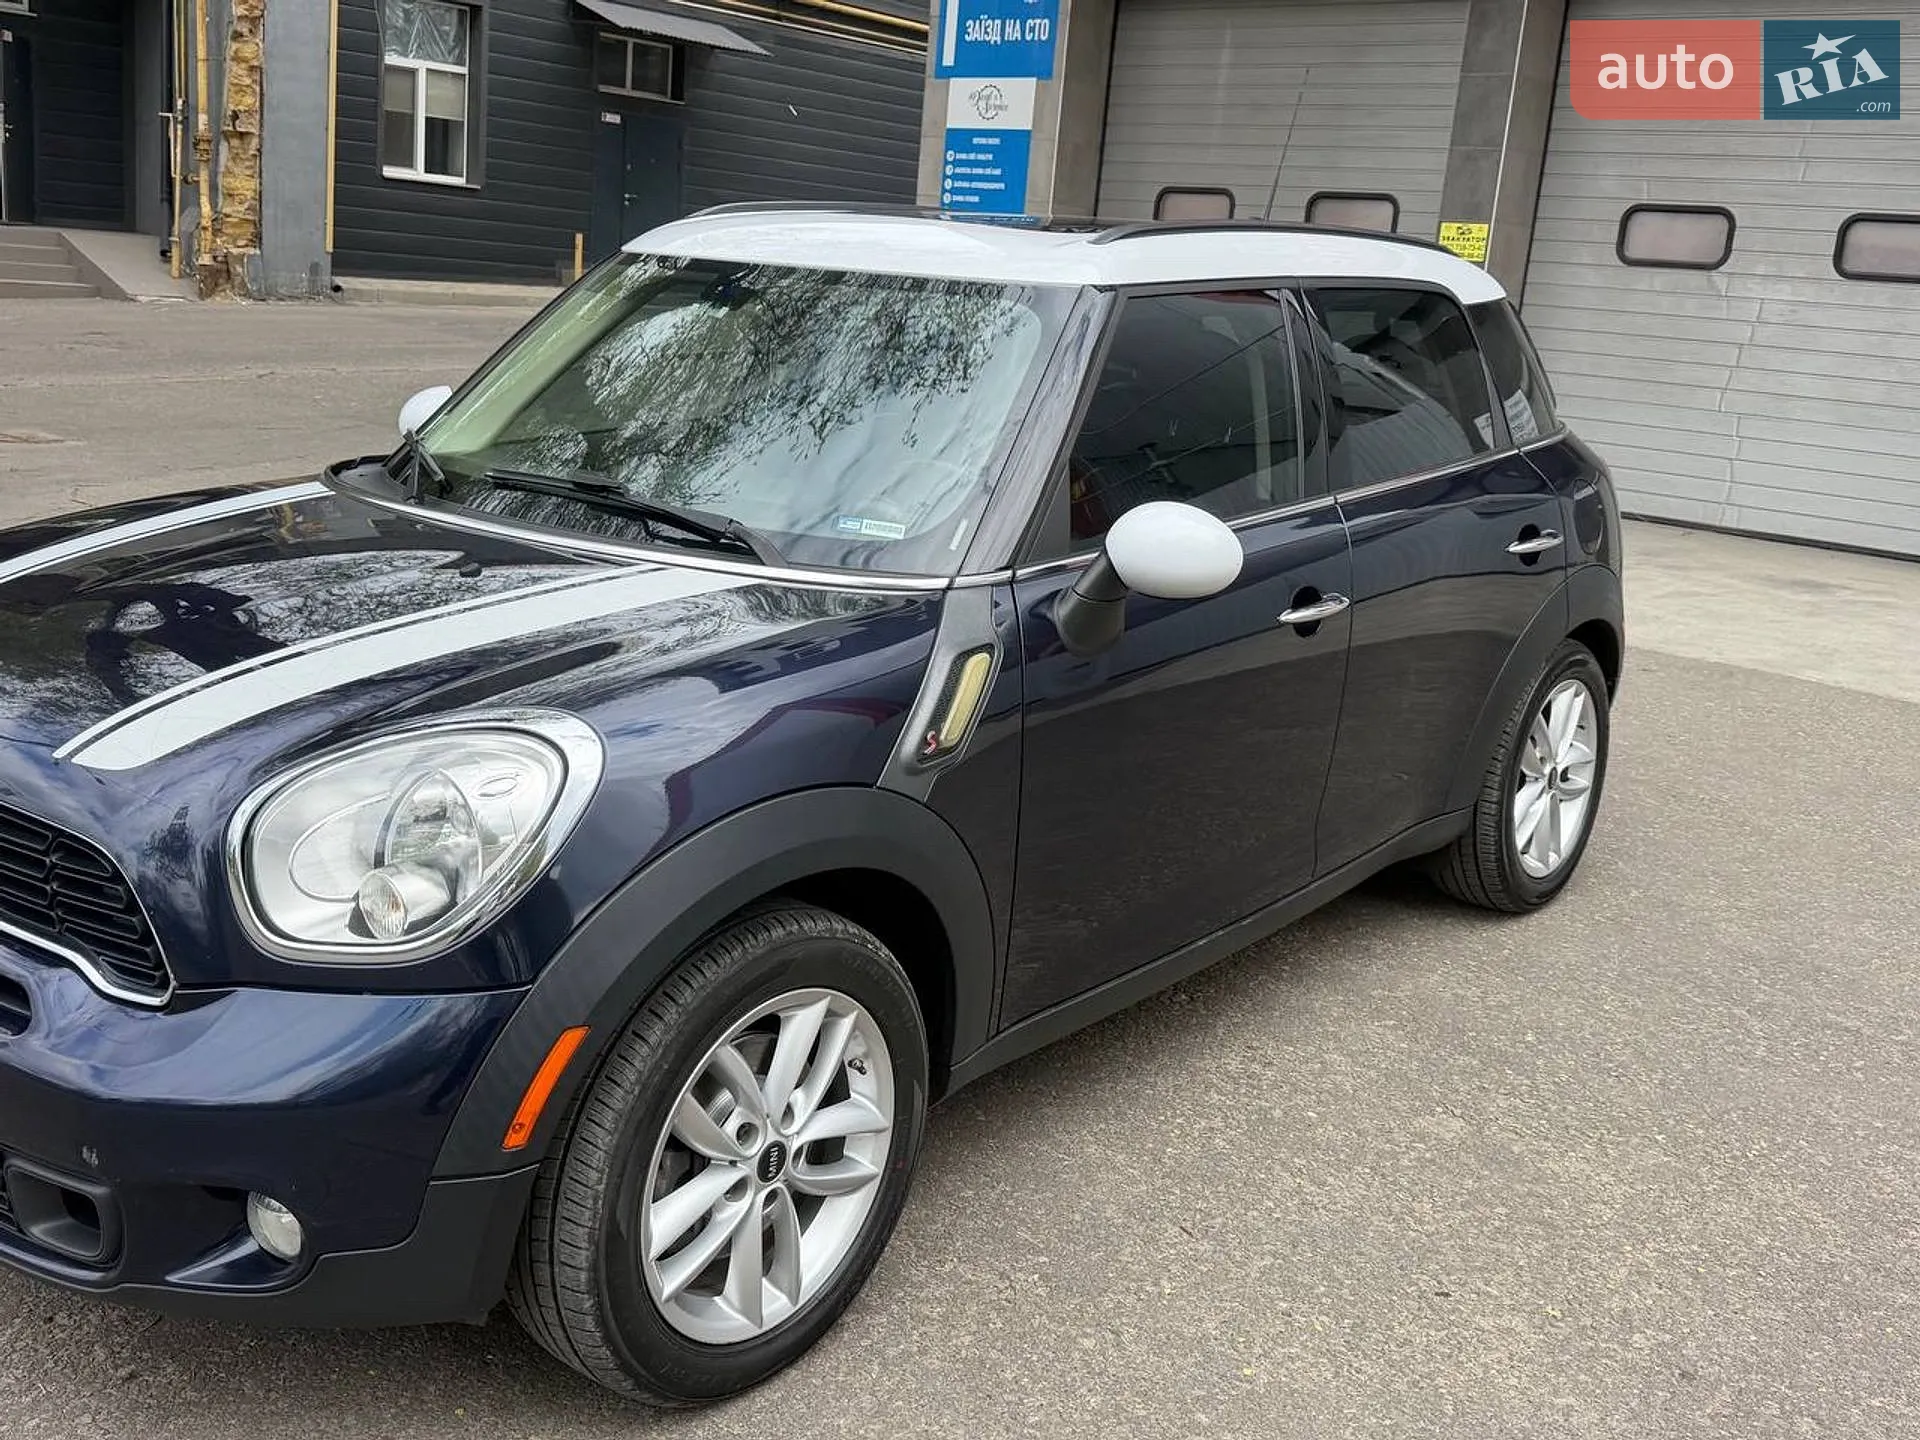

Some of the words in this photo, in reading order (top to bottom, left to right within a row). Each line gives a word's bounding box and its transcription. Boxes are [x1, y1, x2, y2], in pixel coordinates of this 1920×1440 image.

[964, 14, 1001, 44] ЗАЇЗД
[1004, 18, 1022, 41] НА
[1025, 18, 1050, 41] СТО
[768, 1147, 779, 1178] MINI
